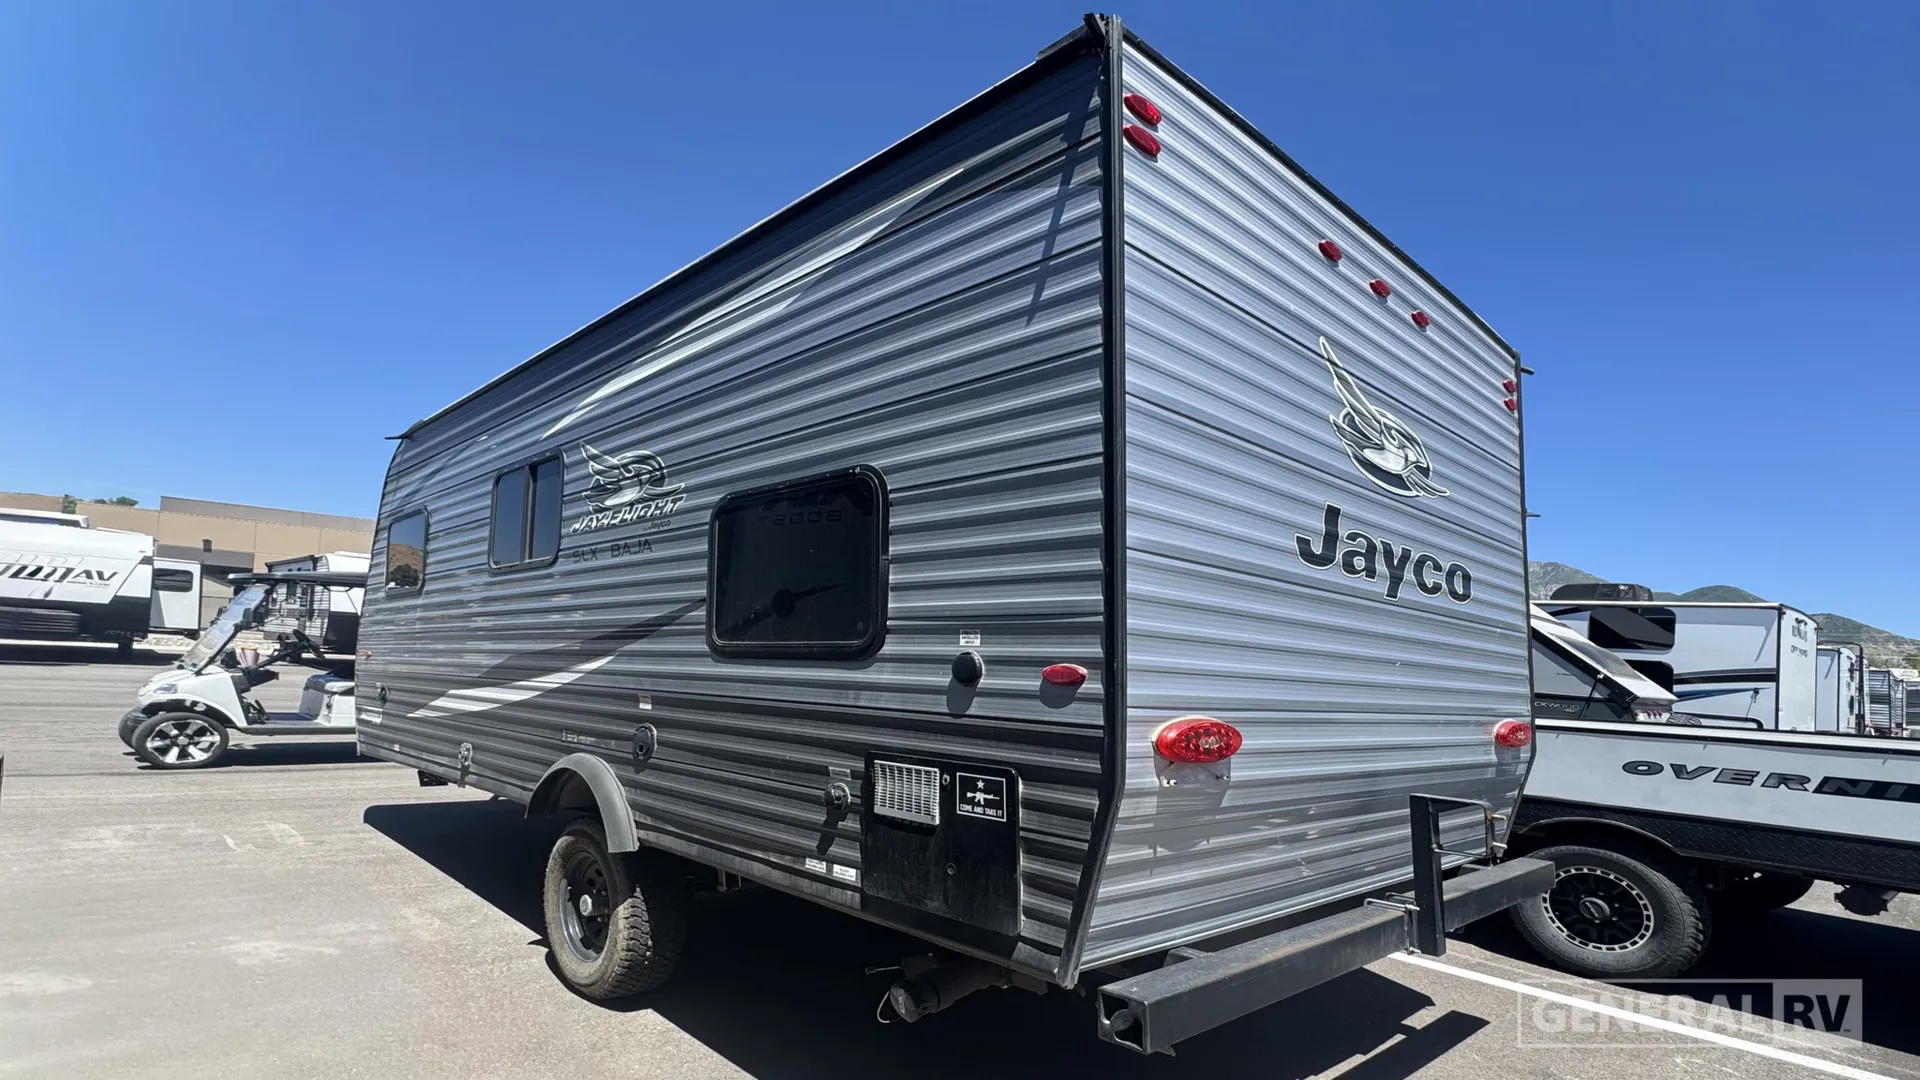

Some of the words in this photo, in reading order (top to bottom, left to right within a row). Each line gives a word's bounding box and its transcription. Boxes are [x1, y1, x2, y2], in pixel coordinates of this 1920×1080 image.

[572, 547, 598, 563] SLX
[610, 538, 653, 558] BAJA
[1295, 502, 1473, 604] Jayco
[1534, 701, 1580, 710] CKWOOD
[960, 803, 973, 812] COME
[973, 805, 984, 814] AND
[984, 807, 997, 817] TAKE
